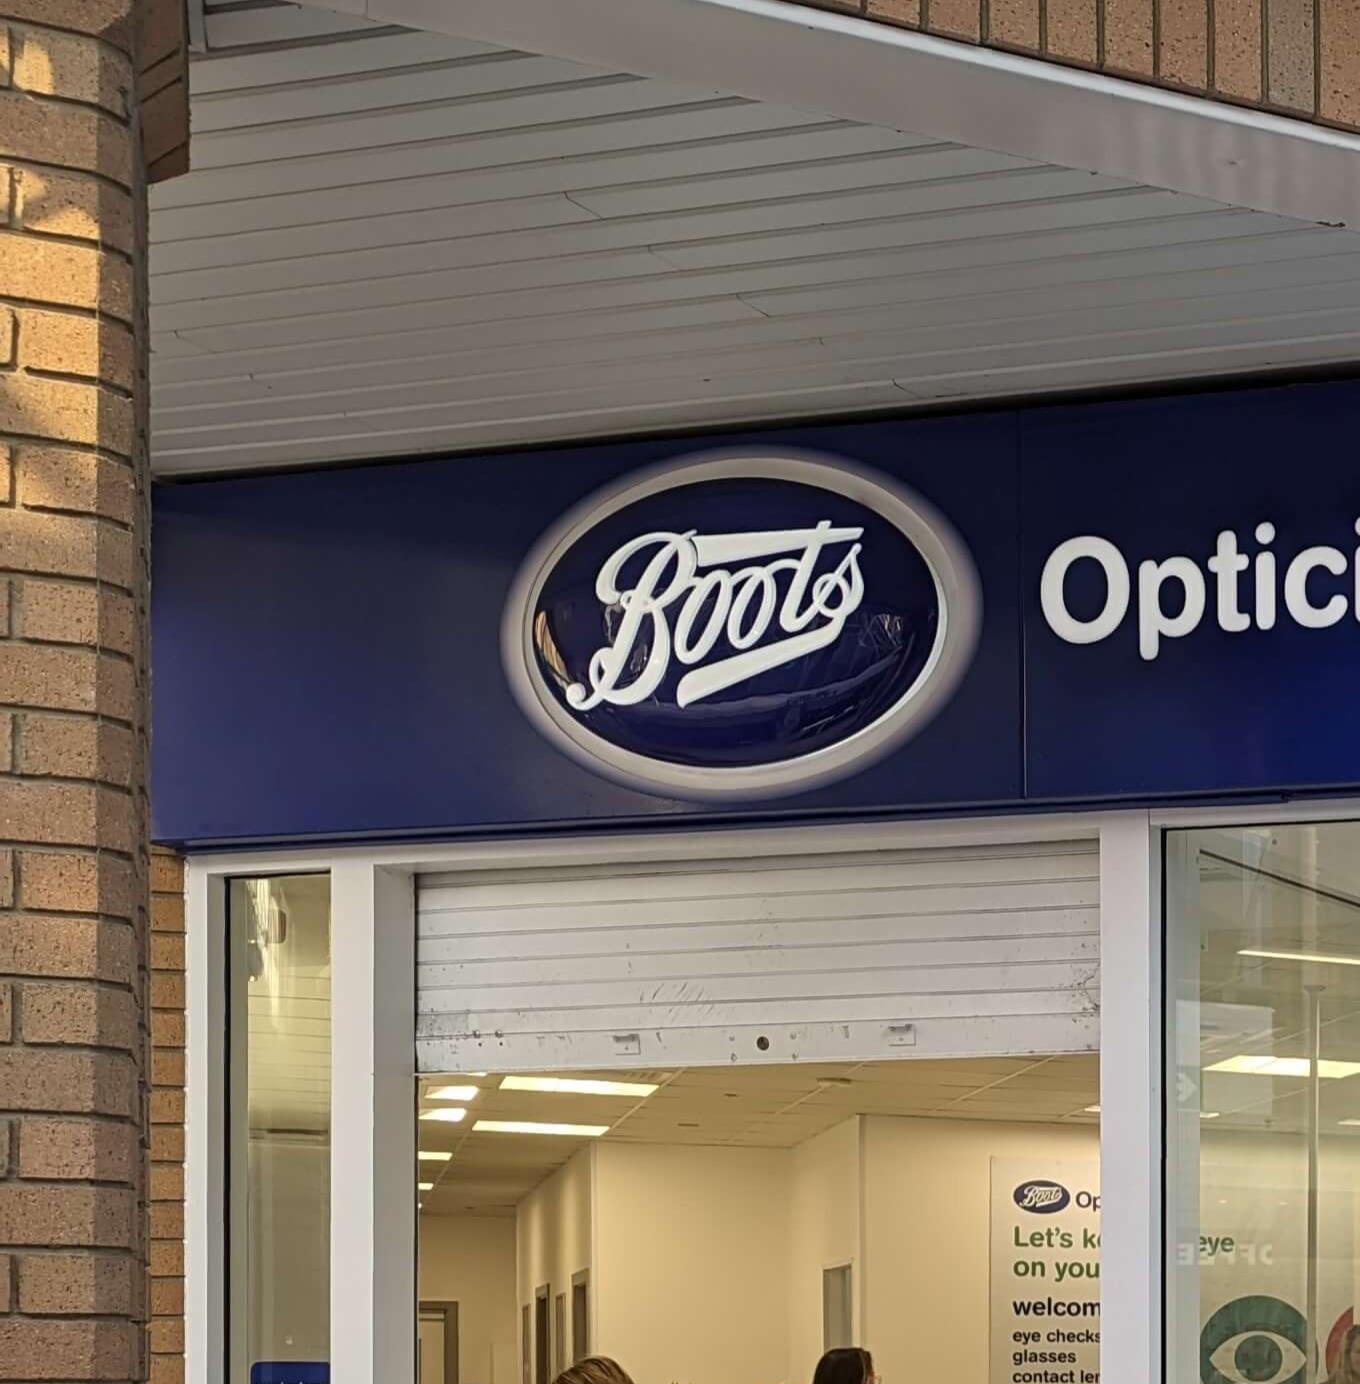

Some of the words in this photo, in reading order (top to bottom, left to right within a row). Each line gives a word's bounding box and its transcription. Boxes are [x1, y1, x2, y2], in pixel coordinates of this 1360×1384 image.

[566, 520, 864, 711] Boots
[1018, 1184, 1064, 1210] Boots
[1013, 1225, 1074, 1249] Let's
[1013, 1260, 1046, 1278] on
[1012, 1330, 1042, 1346] eye
[1012, 1350, 1077, 1366] glasses
[1012, 1369, 1075, 1384] contact
